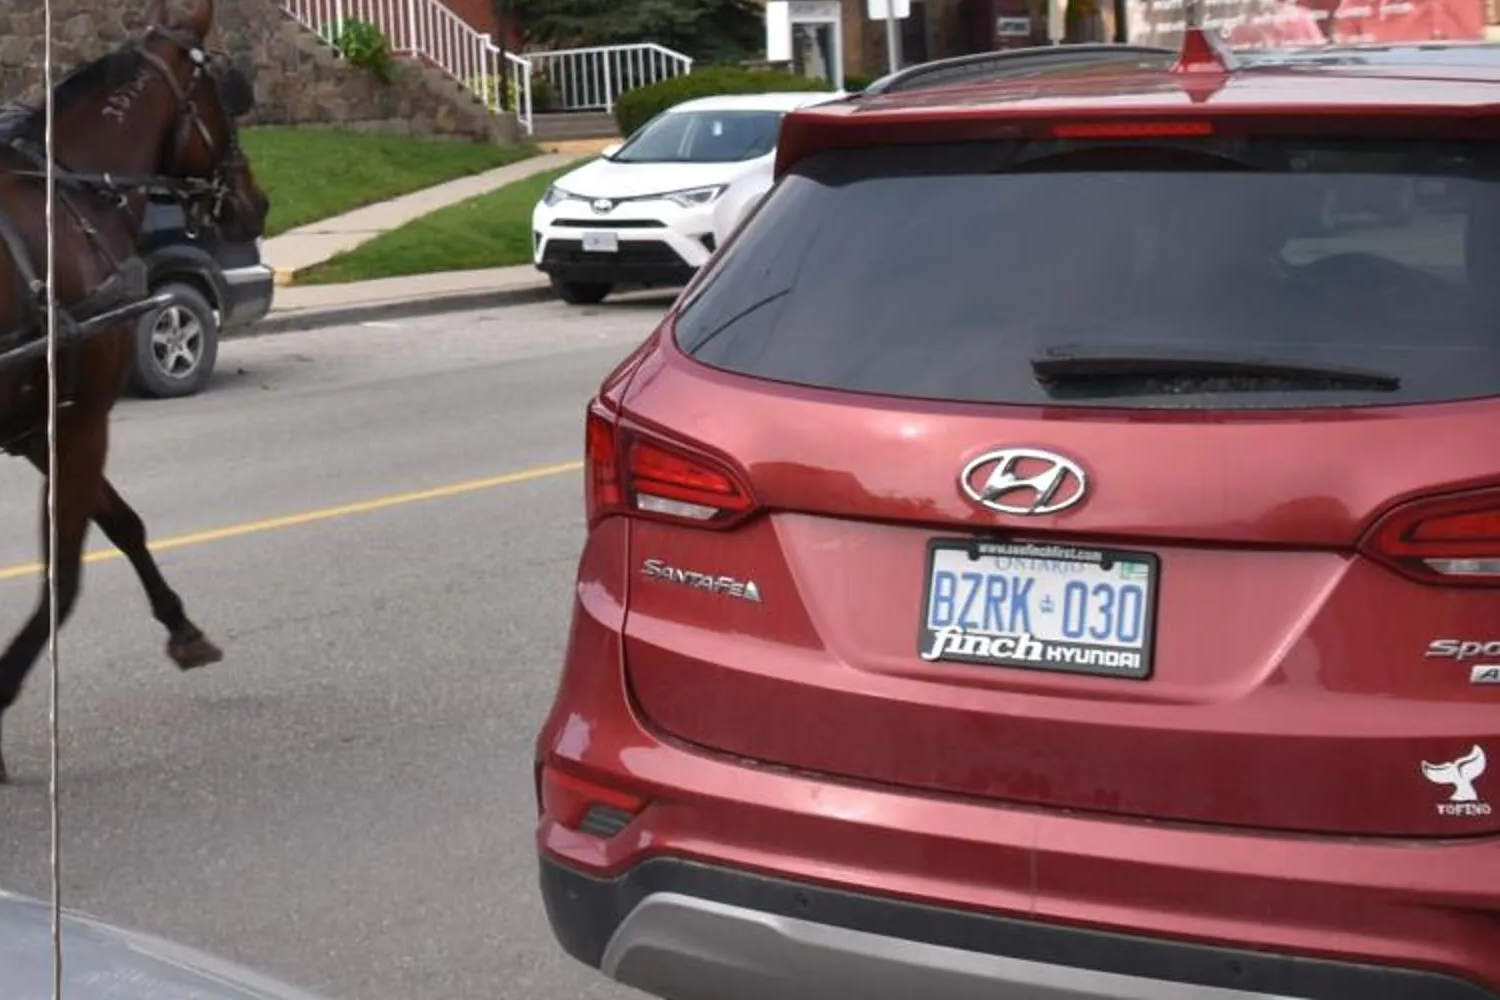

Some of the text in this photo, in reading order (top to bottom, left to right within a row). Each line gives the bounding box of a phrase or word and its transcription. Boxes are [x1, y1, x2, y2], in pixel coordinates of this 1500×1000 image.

[931, 570, 1143, 642] BZRK 030
[921, 625, 1141, 668] finch HYUNDAI
[1436, 803, 1493, 816] TOFINO
